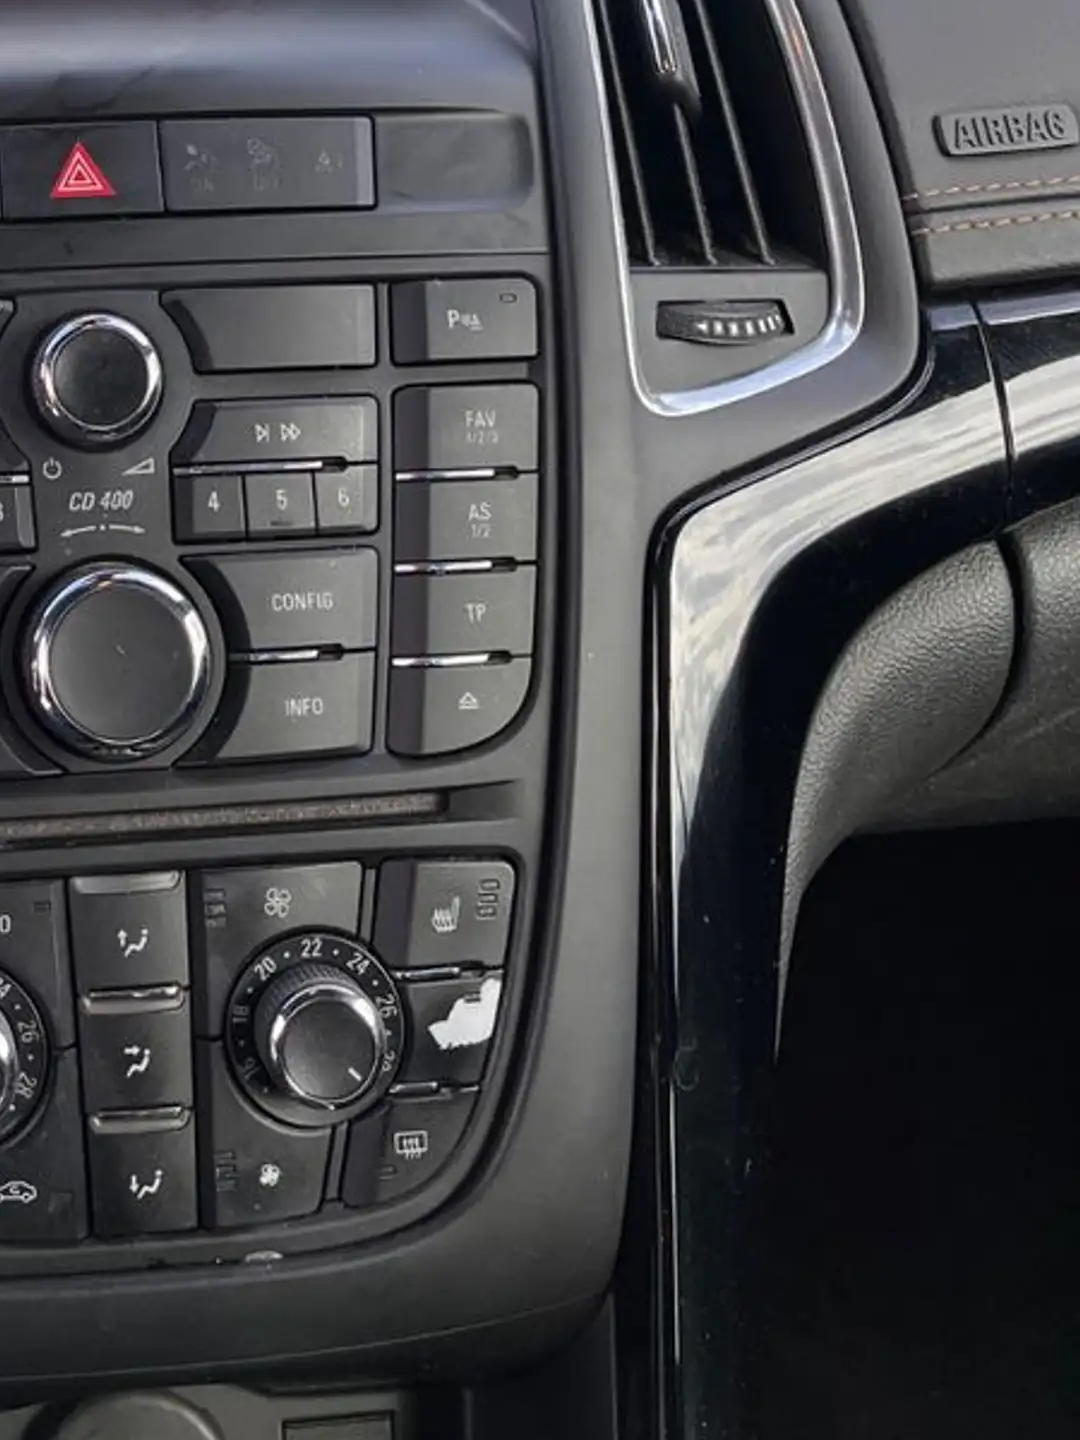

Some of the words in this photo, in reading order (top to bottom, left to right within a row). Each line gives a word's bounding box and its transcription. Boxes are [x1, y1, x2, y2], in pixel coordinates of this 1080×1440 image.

[954, 110, 1066, 149] AIRBAG
[465, 409, 496, 428] FAV
[69, 491, 95, 511] CD
[100, 489, 133, 510] 400
[208, 492, 220, 512] 4
[276, 488, 288, 509] 5
[338, 488, 350, 508] 6
[468, 501, 492, 521] AS
[271, 591, 334, 612] CONFIG
[466, 603, 486, 622] TP
[283, 696, 324, 716] INFO
[300, 938, 323, 958] 22
[254, 956, 277, 981] 20
[345, 952, 370, 975] 24
[232, 1005, 249, 1023] 18
[375, 993, 398, 1018] 26
[17, 1020, 39, 1043] 26
[14, 1072, 38, 1099] 28
